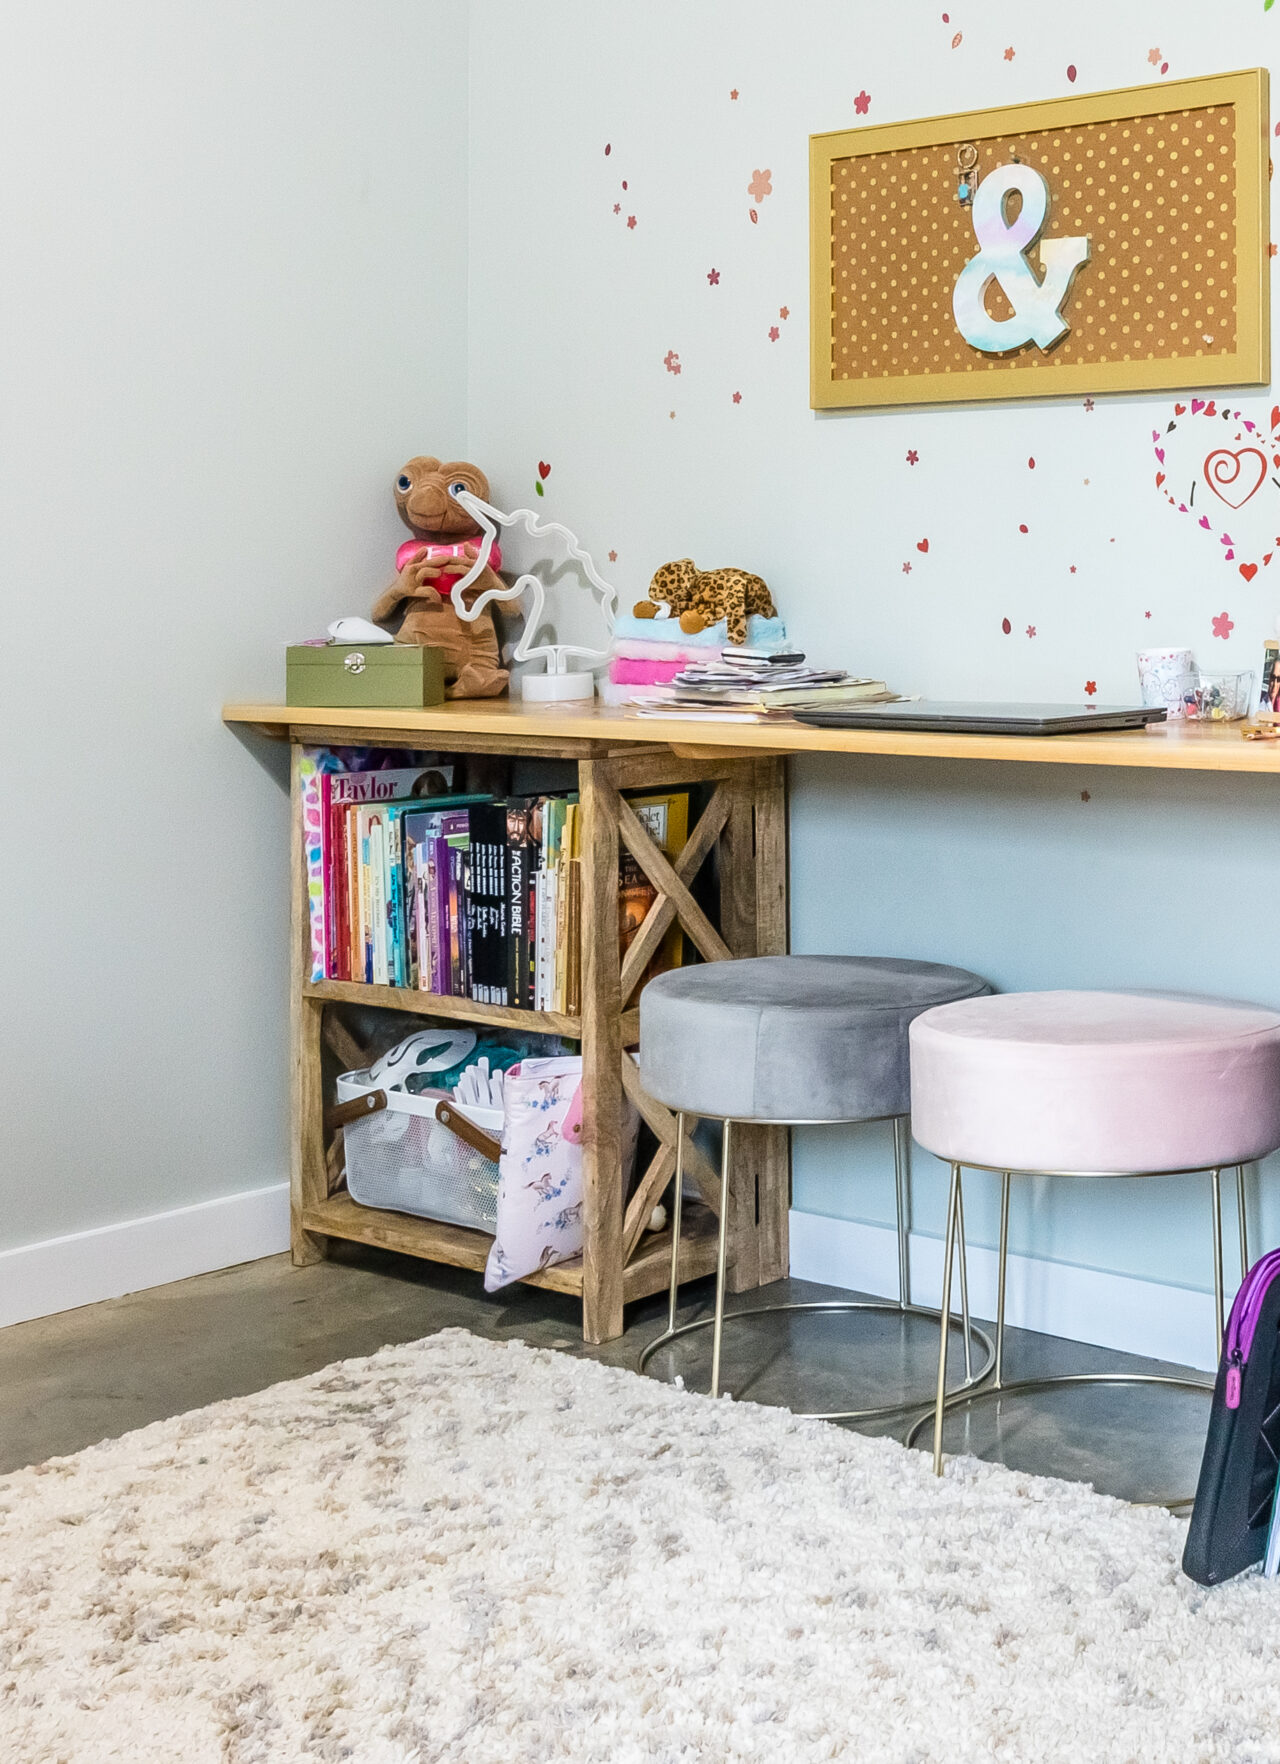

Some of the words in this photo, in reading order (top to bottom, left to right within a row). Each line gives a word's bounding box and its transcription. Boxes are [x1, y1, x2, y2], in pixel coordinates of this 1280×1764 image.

[1190, 481, 1196, 506] I
[335, 776, 398, 800] Taylor
[511, 856, 522, 904] ACTION
[511, 905, 522, 935] BIBLE
